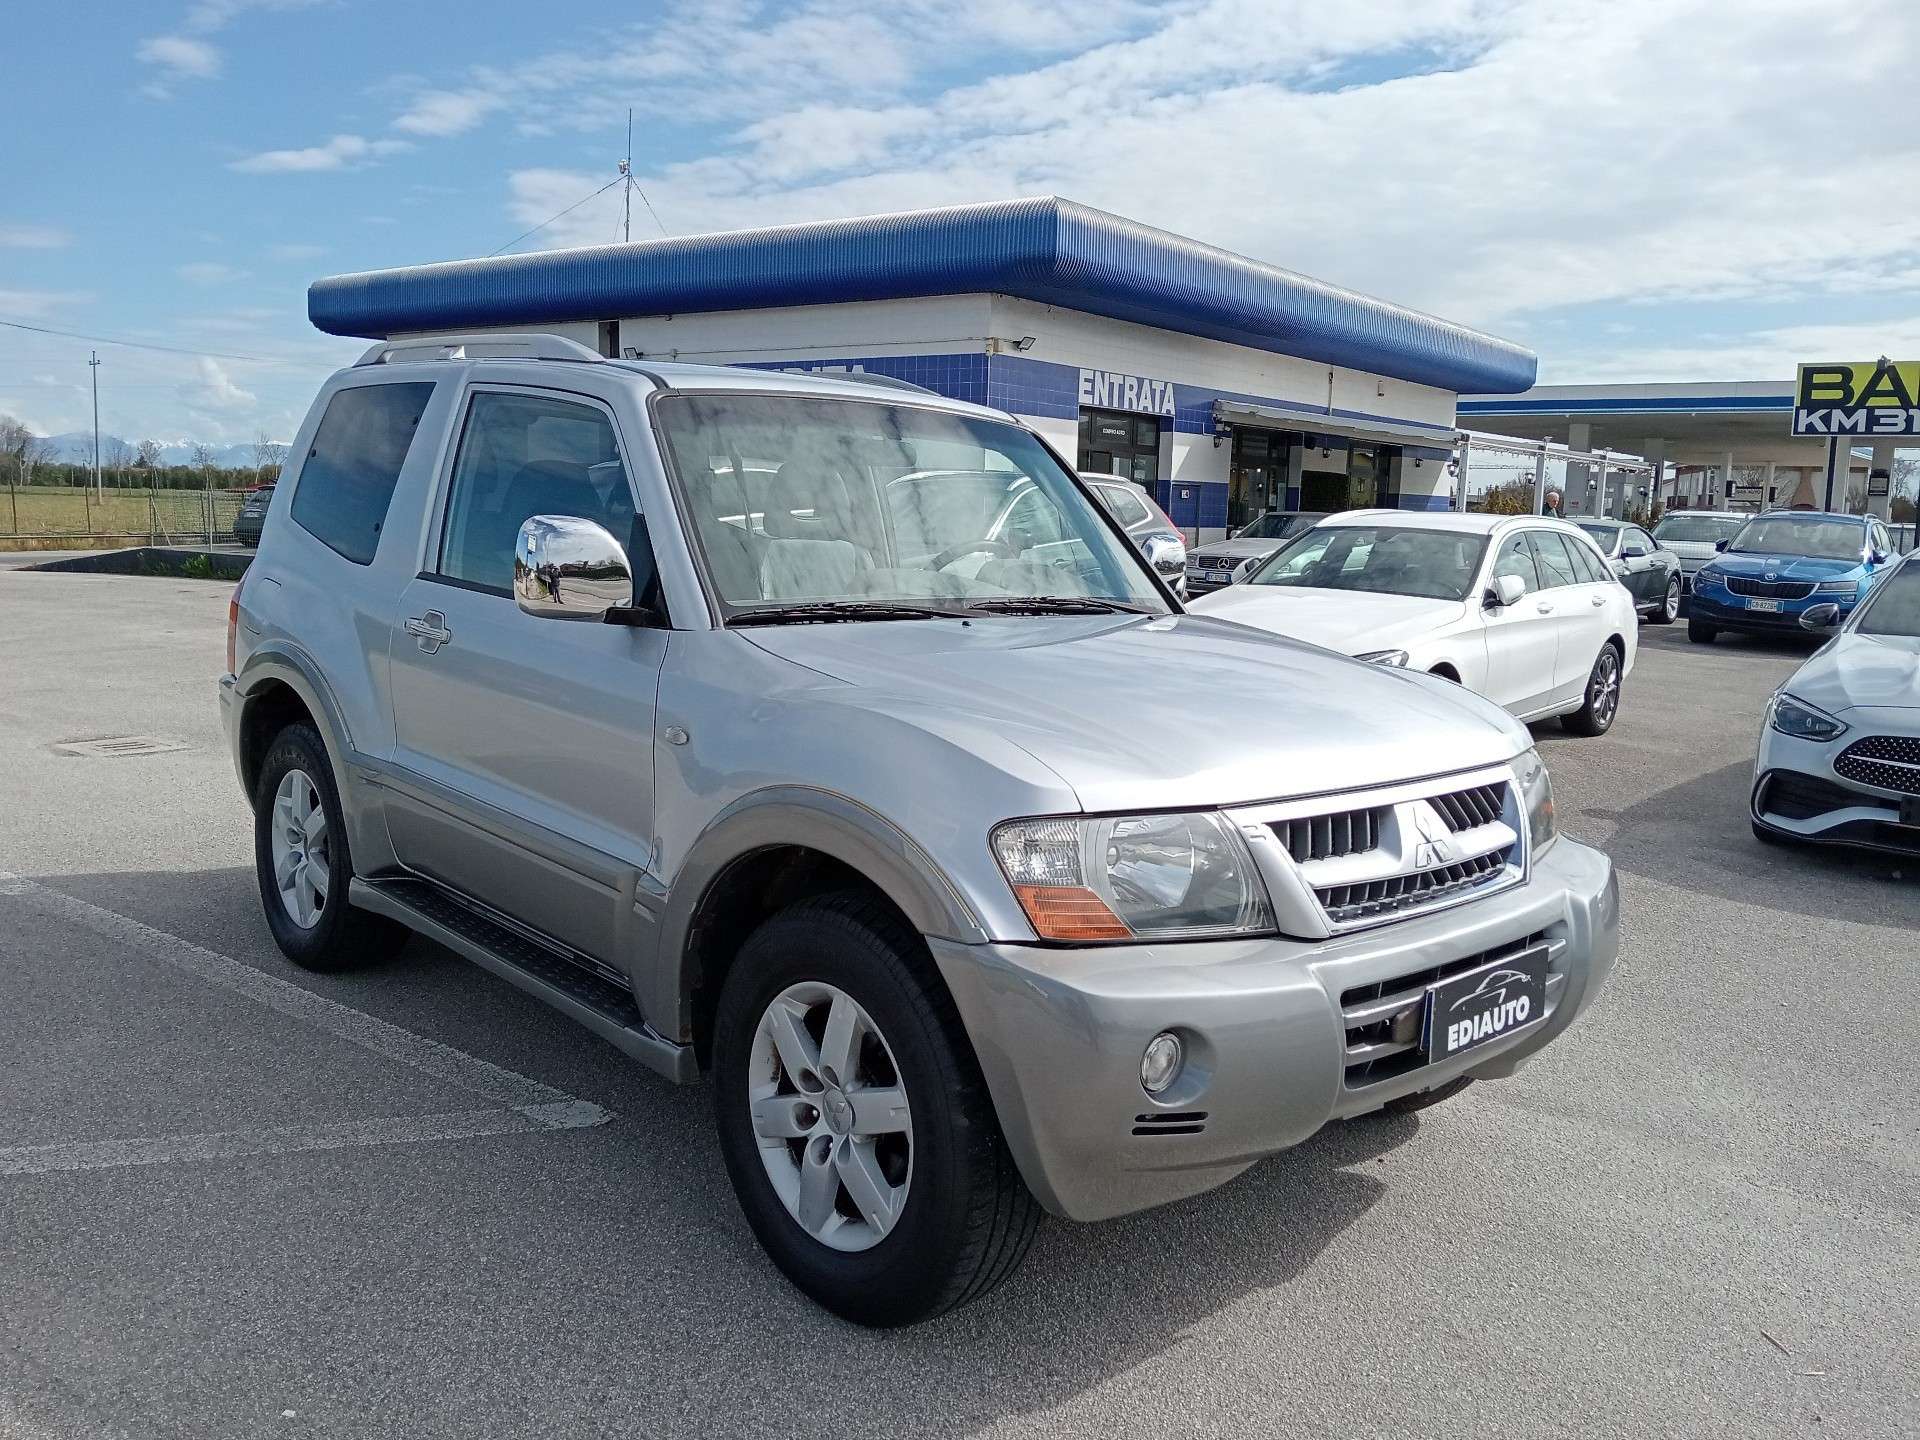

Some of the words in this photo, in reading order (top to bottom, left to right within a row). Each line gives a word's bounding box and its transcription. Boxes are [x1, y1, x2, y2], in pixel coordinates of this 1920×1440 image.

[1079, 368, 1176, 416] ENTRATA
[1800, 365, 1920, 408] BA
[1447, 995, 1530, 1052] EDIAUTO
